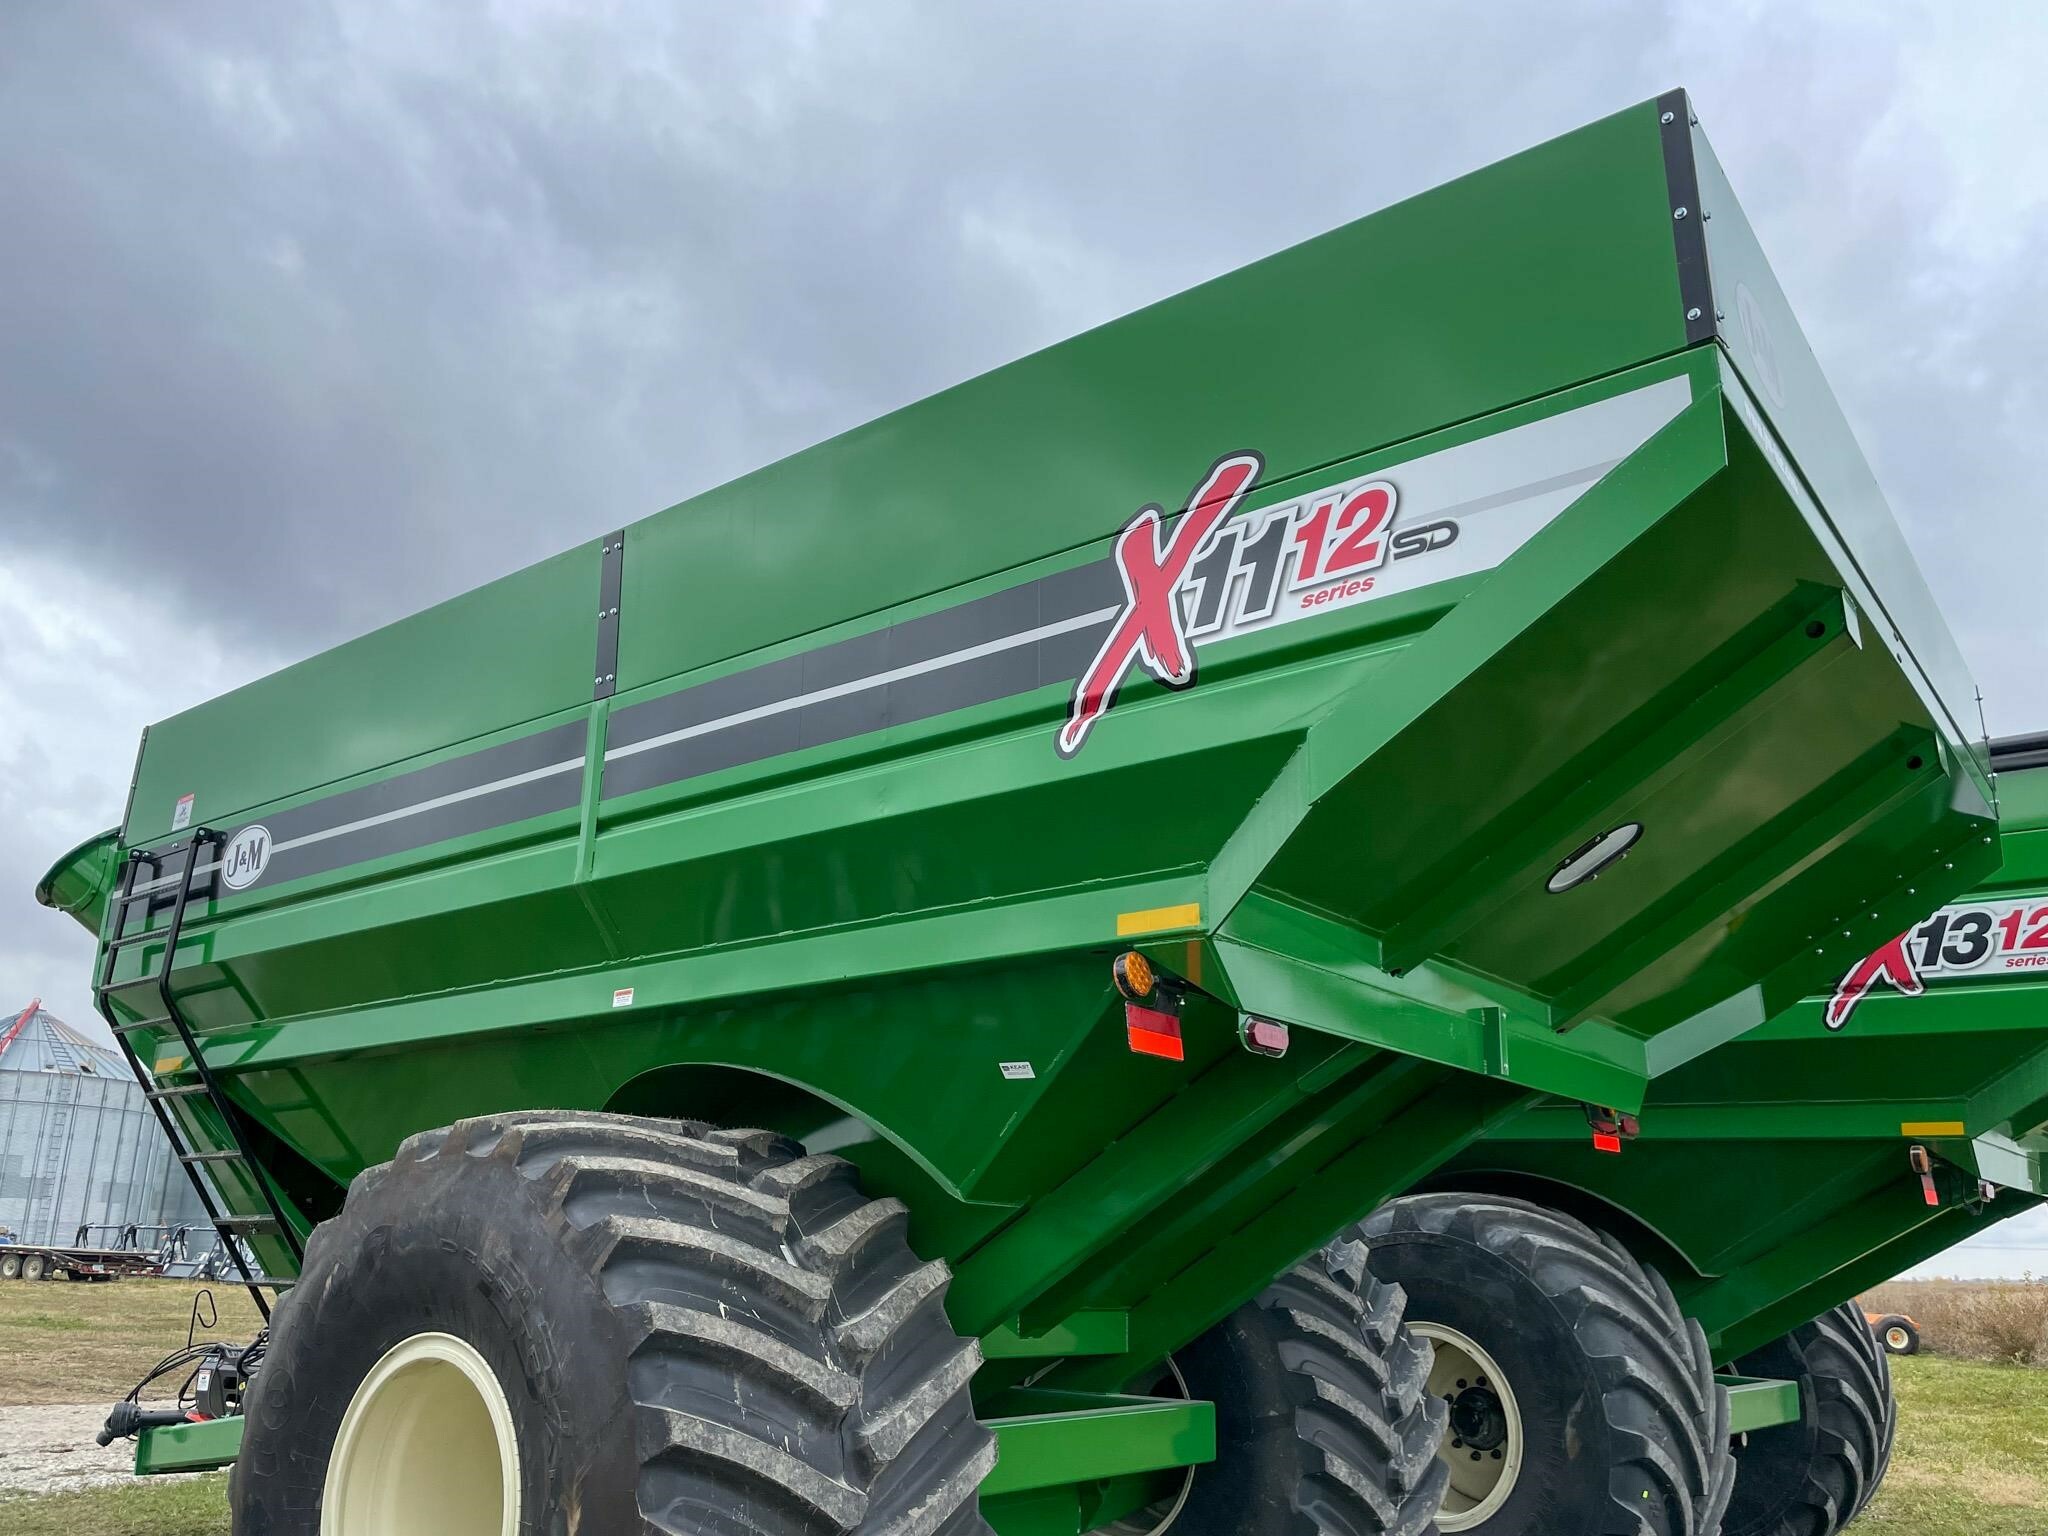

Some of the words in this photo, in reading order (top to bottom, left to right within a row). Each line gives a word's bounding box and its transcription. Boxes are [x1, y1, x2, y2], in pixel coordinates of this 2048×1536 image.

[1390, 519, 1460, 563] SD
[1300, 575, 1376, 609] series
[226, 837, 265, 878] J&M
[2005, 952, 2048, 968] serie
